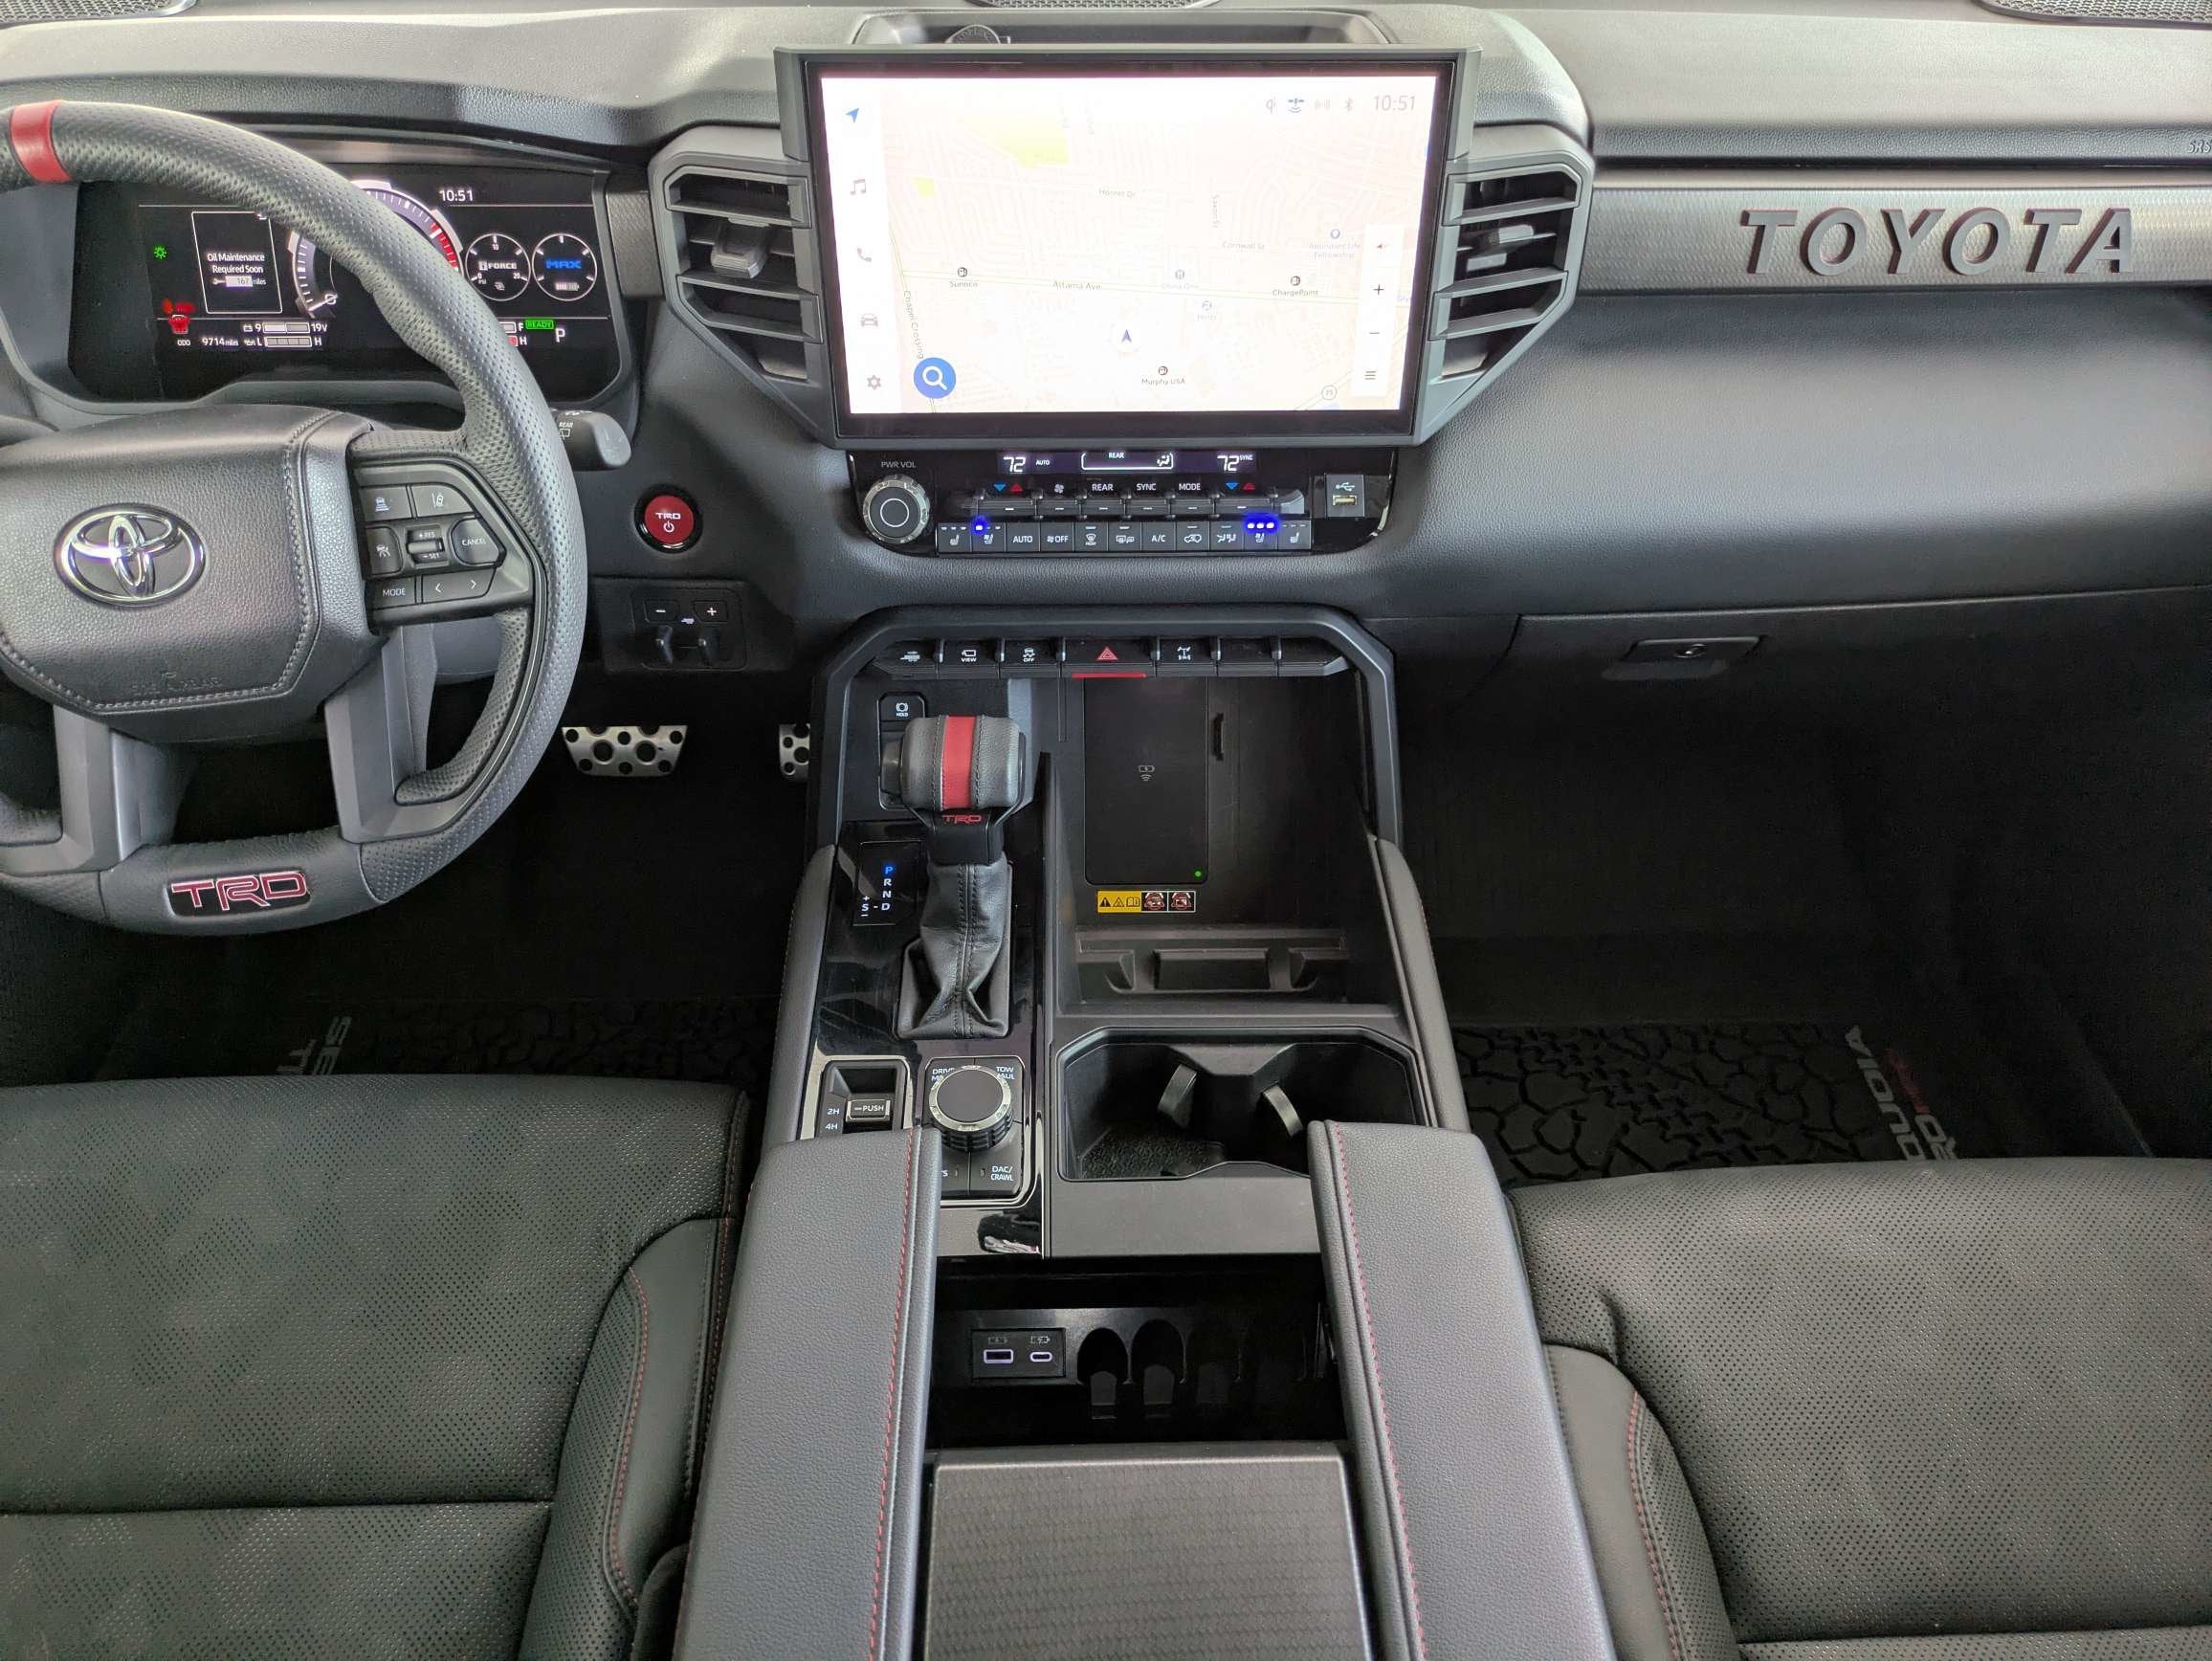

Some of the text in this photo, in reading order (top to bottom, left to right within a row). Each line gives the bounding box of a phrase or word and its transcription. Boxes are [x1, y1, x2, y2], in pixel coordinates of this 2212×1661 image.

[1374, 95, 1417, 111] 10:51
[2187, 139, 2211, 153] SRS
[438, 188, 475, 202] 10:51
[1739, 207, 2134, 276] TOYOTA
[207, 253, 265, 261] Oil Maintenance
[545, 259, 583, 269] MAX
[212, 264, 264, 275] Required Soon
[1272, 289, 1318, 299] ChargePoint
[254, 321, 262, 332] 9
[525, 320, 553, 328] READY
[555, 327, 565, 343] P
[201, 337, 225, 346] 9714
[256, 337, 263, 346] L
[314, 337, 322, 346] H
[519, 336, 527, 345] H
[1140, 378, 1169, 388] Murphy
[1003, 456, 1027, 473] 72
[1216, 454, 1240, 472] 72
[1136, 482, 1157, 491] SYNC
[1178, 482, 1202, 491] MODE
[461, 538, 487, 546] CANCEL
[1151, 535, 1166, 543] A/C
[383, 588, 407, 597] MODE
[941, 814, 982, 824] TRD
[884, 866, 894, 875] P
[170, 871, 307, 911] TRD
[882, 890, 892, 898] N
[861, 903, 870, 912] S
[881, 902, 891, 911] D
